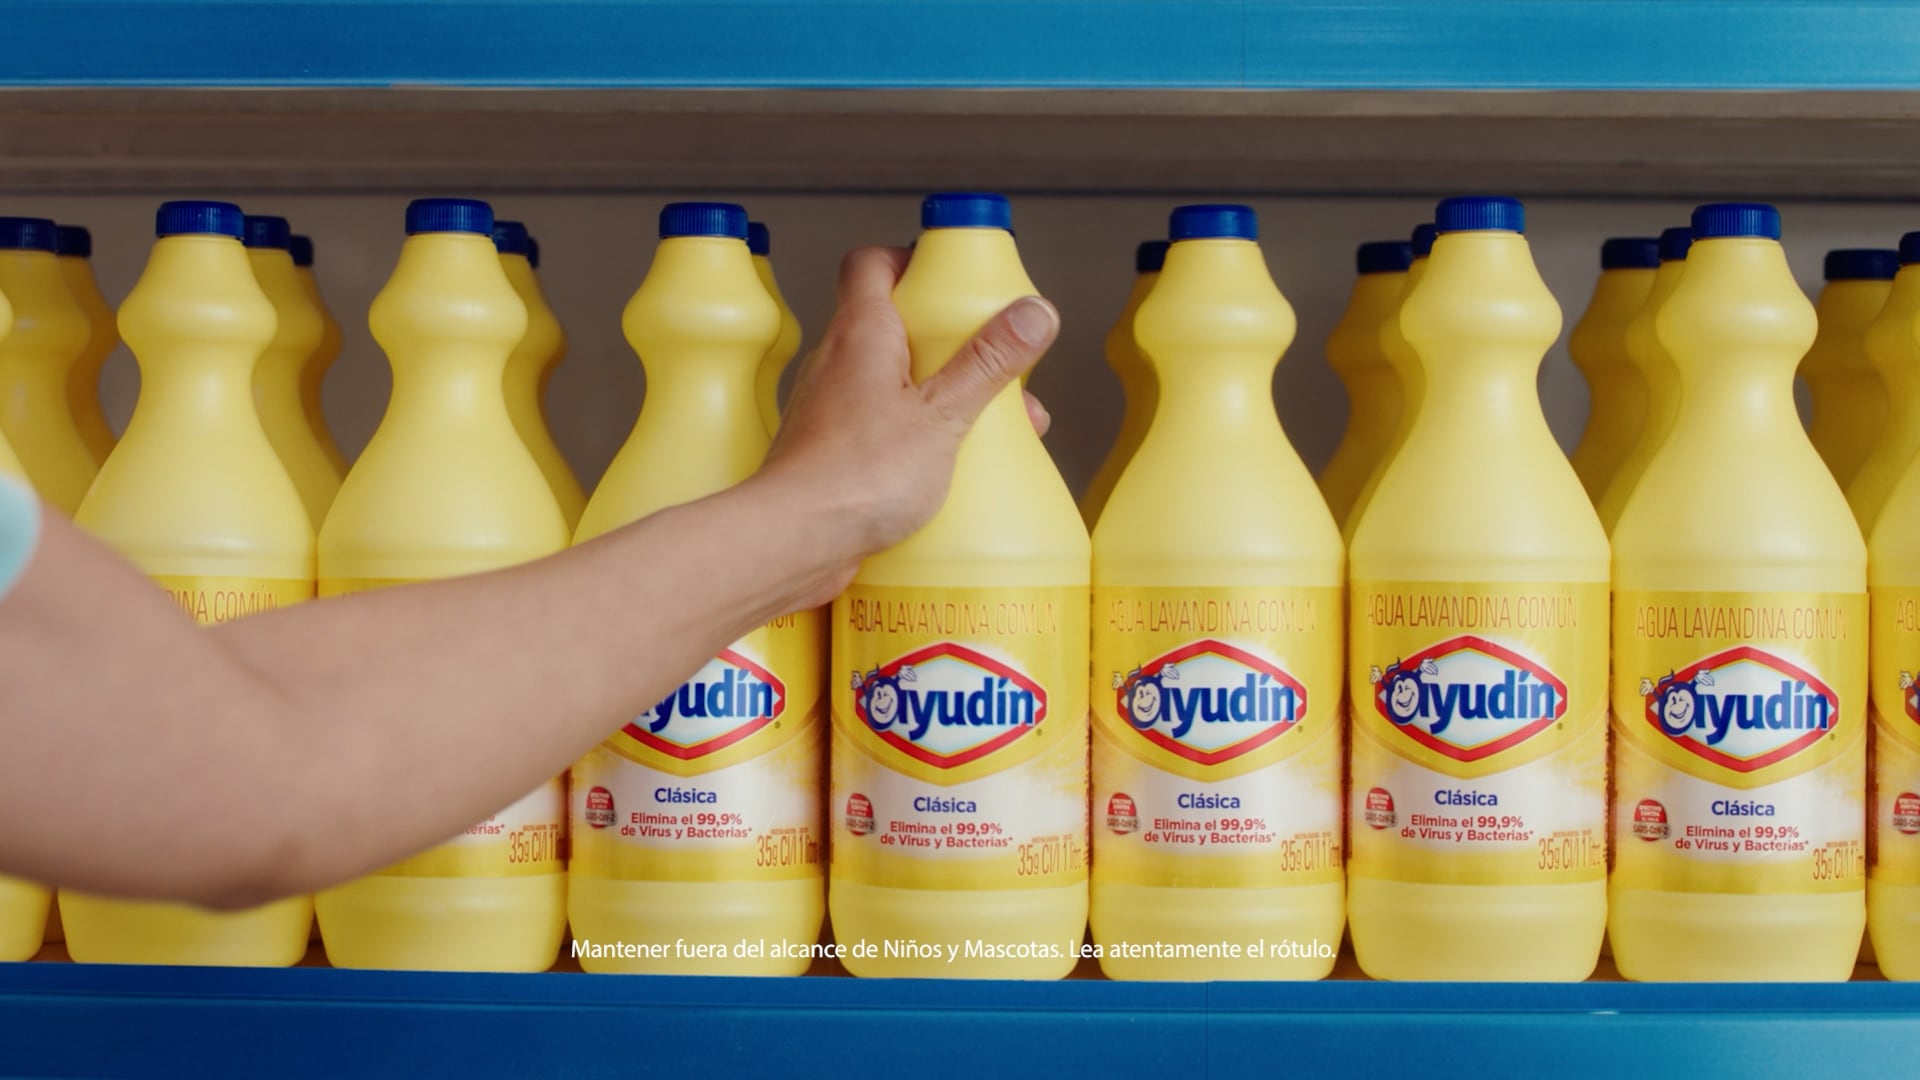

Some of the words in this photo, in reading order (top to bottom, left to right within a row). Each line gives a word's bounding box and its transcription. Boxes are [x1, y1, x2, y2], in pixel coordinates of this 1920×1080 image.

[850, 599, 883, 632] AGUA
[888, 601, 990, 634] LAVANDINA
[1150, 600, 1251, 632] LAVANDINA
[1367, 594, 1405, 626] AGUA
[1409, 595, 1512, 628] LAVANDINA
[1636, 606, 1679, 638] AGUA
[1684, 606, 1788, 639] LAVANDINA
[641, 668, 773, 733] yudín
[654, 787, 717, 804] Clásica
[1177, 793, 1240, 809] Clásica
[1434, 790, 1498, 806] Clásica
[913, 796, 977, 813] Clásica
[1711, 800, 1775, 817] Clásica
[631, 812, 677, 825] Elimina
[681, 813, 693, 825] el
[697, 813, 742, 827] 99,9%
[1154, 818, 1201, 830] Elimina
[1205, 818, 1216, 831] el
[1221, 819, 1266, 832] 99,9%
[1411, 815, 1458, 828] Elimina
[1461, 815, 1473, 828] el
[1478, 816, 1524, 829] 99,9%
[621, 825, 636, 837] de
[639, 825, 671, 838] Virus
[675, 828, 682, 840] y
[890, 821, 937, 834] Elimina
[940, 822, 952, 835] el
[956, 823, 1003, 837] 99,9%
[1401, 827, 1416, 839] de
[1419, 827, 1452, 840] Virus
[1455, 830, 1462, 842] y
[1686, 825, 1735, 838] Elimina
[1738, 826, 1750, 838] el
[1755, 826, 1799, 840] 99,9%
[880, 833, 895, 846] de
[898, 833, 931, 847] Virus
[934, 836, 941, 849] y
[1144, 830, 1159, 843] de
[1162, 830, 1195, 843] Virus
[1199, 833, 1205, 846] y
[1675, 837, 1690, 850] de
[1695, 838, 1729, 850] Virus
[1732, 841, 1739, 853] y
